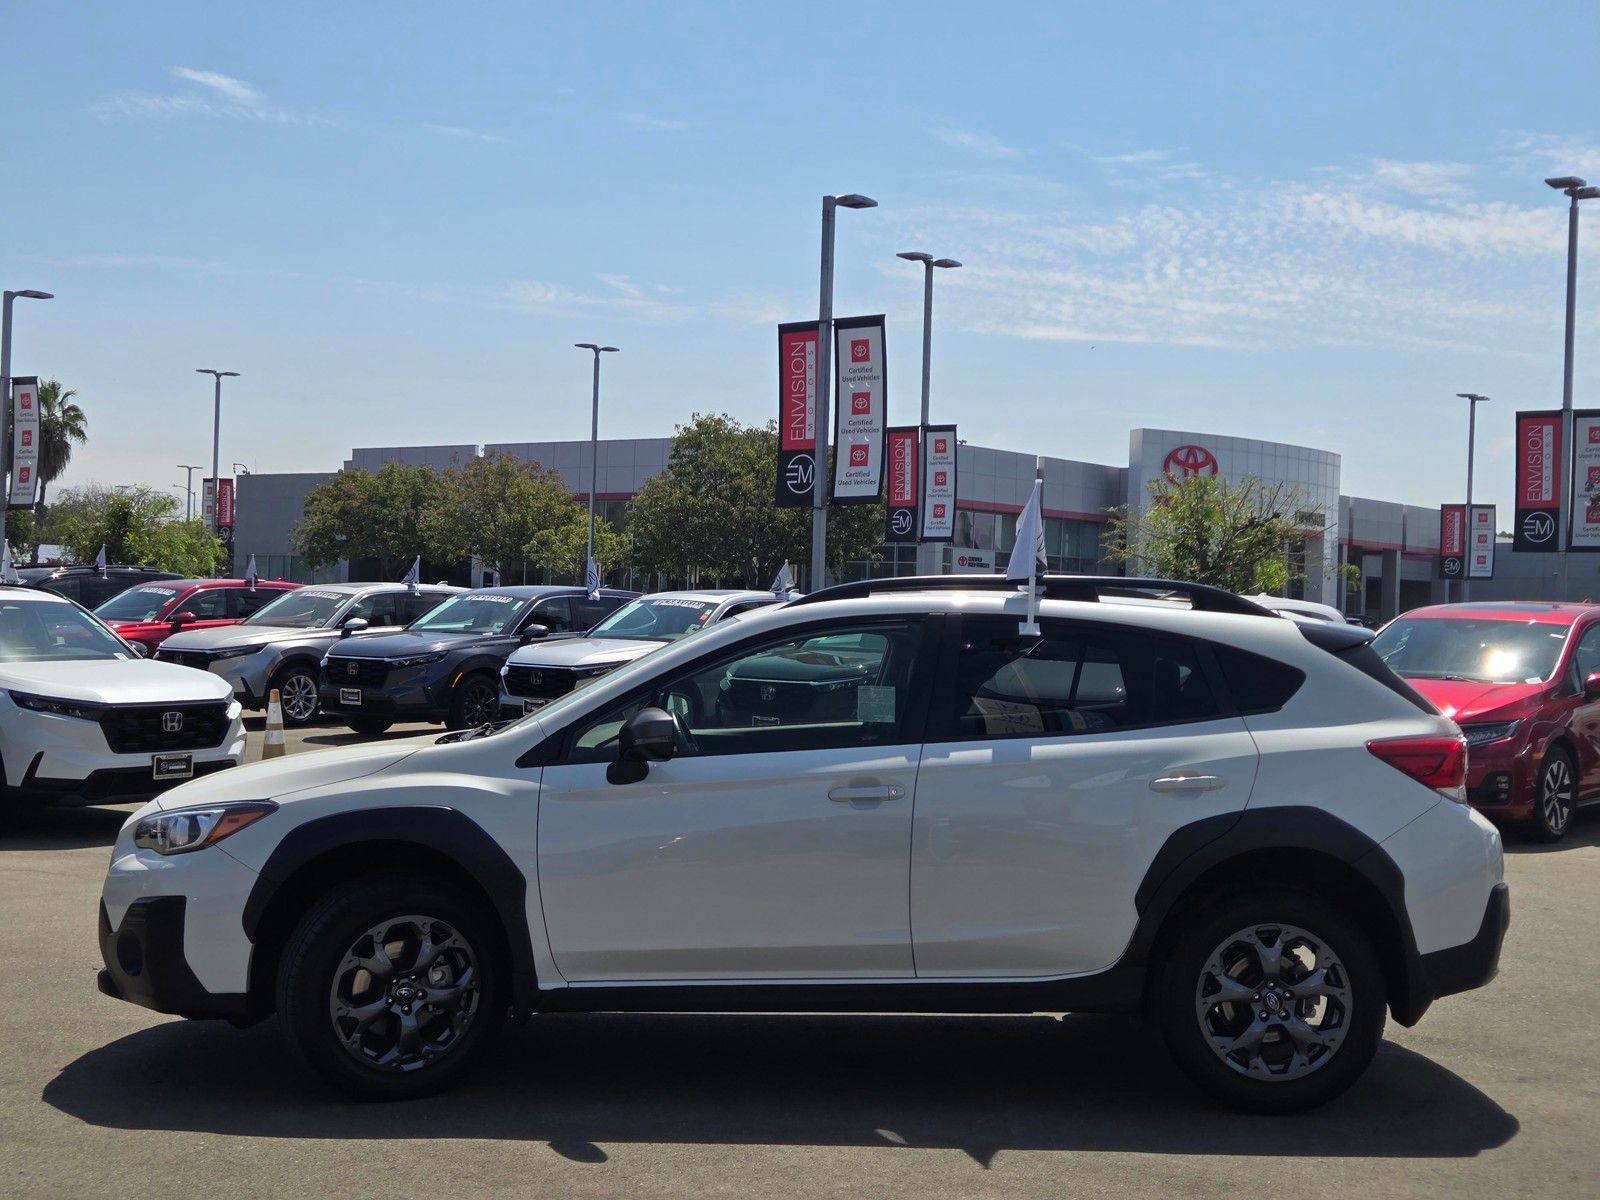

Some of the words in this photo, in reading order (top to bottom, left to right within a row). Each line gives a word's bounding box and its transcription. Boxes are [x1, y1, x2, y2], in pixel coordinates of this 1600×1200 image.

[848, 366, 872, 374] Certified
[842, 374, 856, 382] Used
[856, 374, 880, 382] Vehicles
[791, 342, 806, 440] ENVISION
[848, 419, 872, 427] Certified
[1528, 425, 1542, 502] ENVISION
[895, 438, 904, 500] ENVISION
[853, 478, 876, 486] Vehicles
